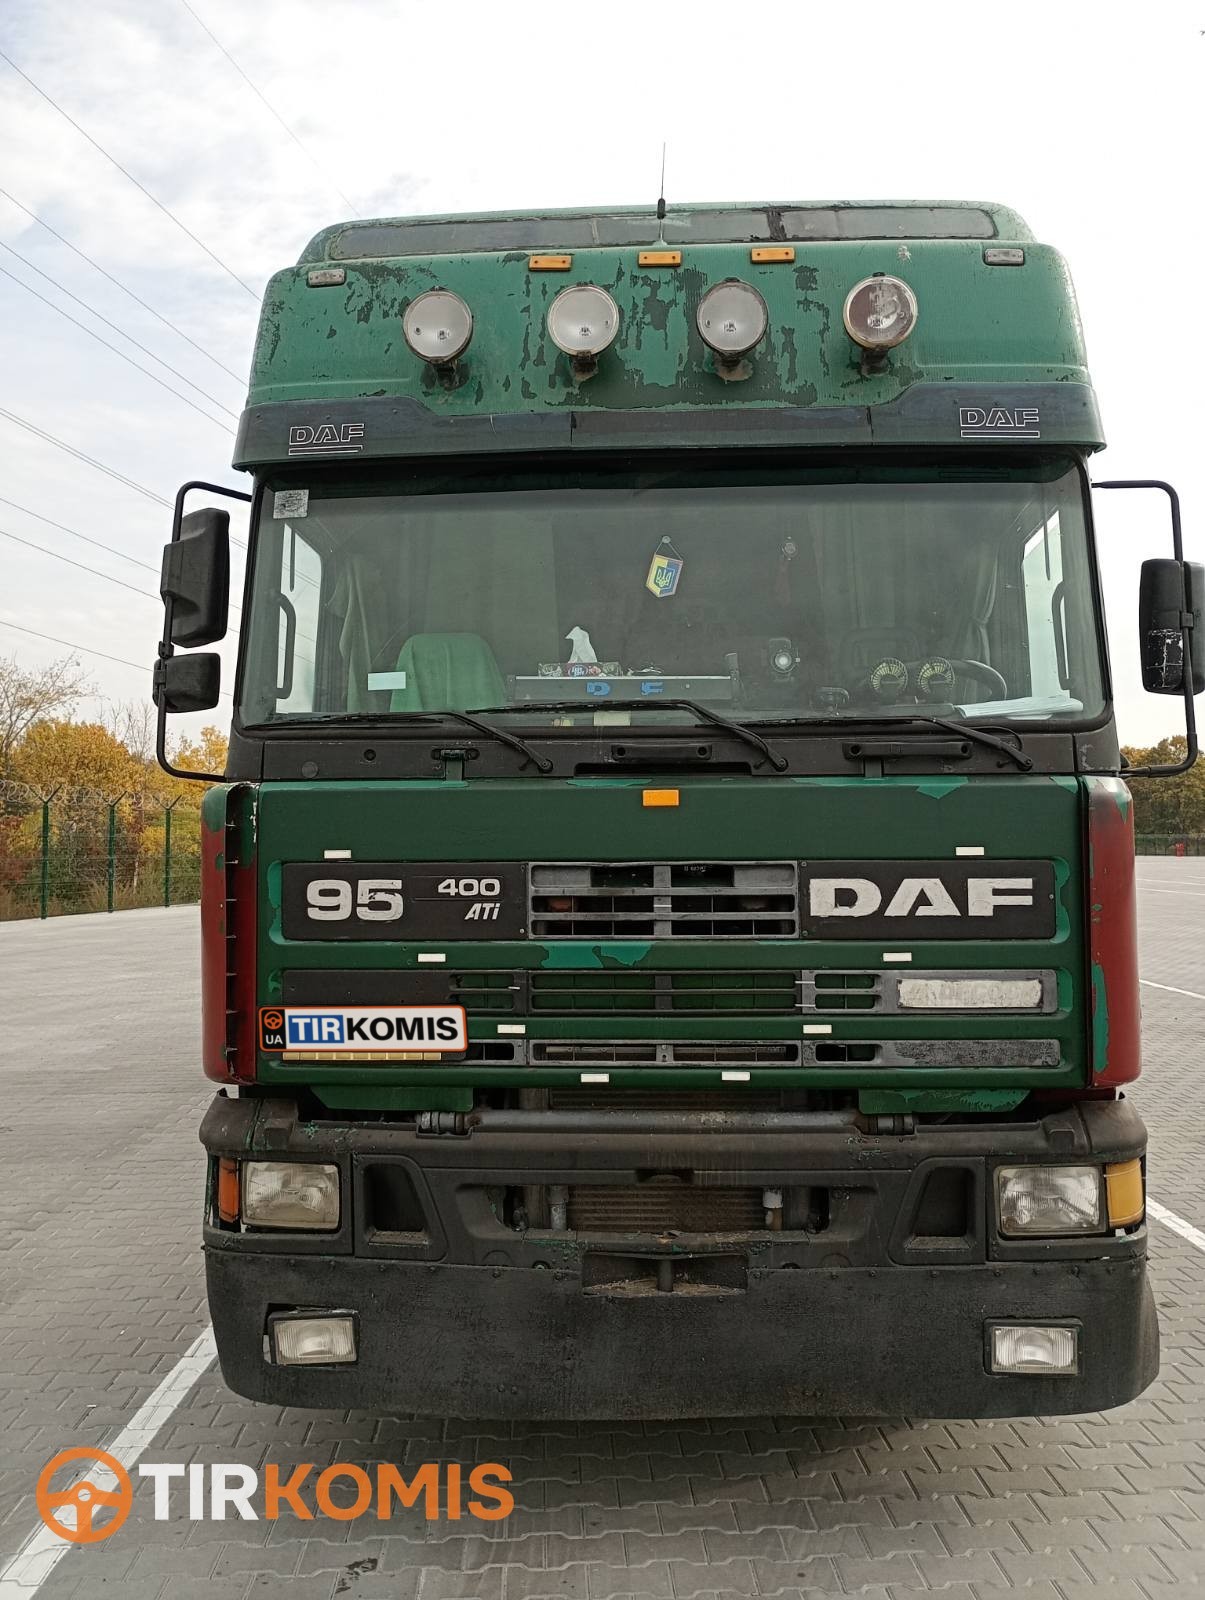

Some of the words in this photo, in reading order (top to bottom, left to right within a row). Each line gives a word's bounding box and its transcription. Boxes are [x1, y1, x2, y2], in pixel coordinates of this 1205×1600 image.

[960, 407, 1039, 427] DAF
[289, 423, 365, 445] DAF
[437, 878, 501, 896] 400
[809, 877, 1033, 917] DAF
[306, 879, 404, 921] 95
